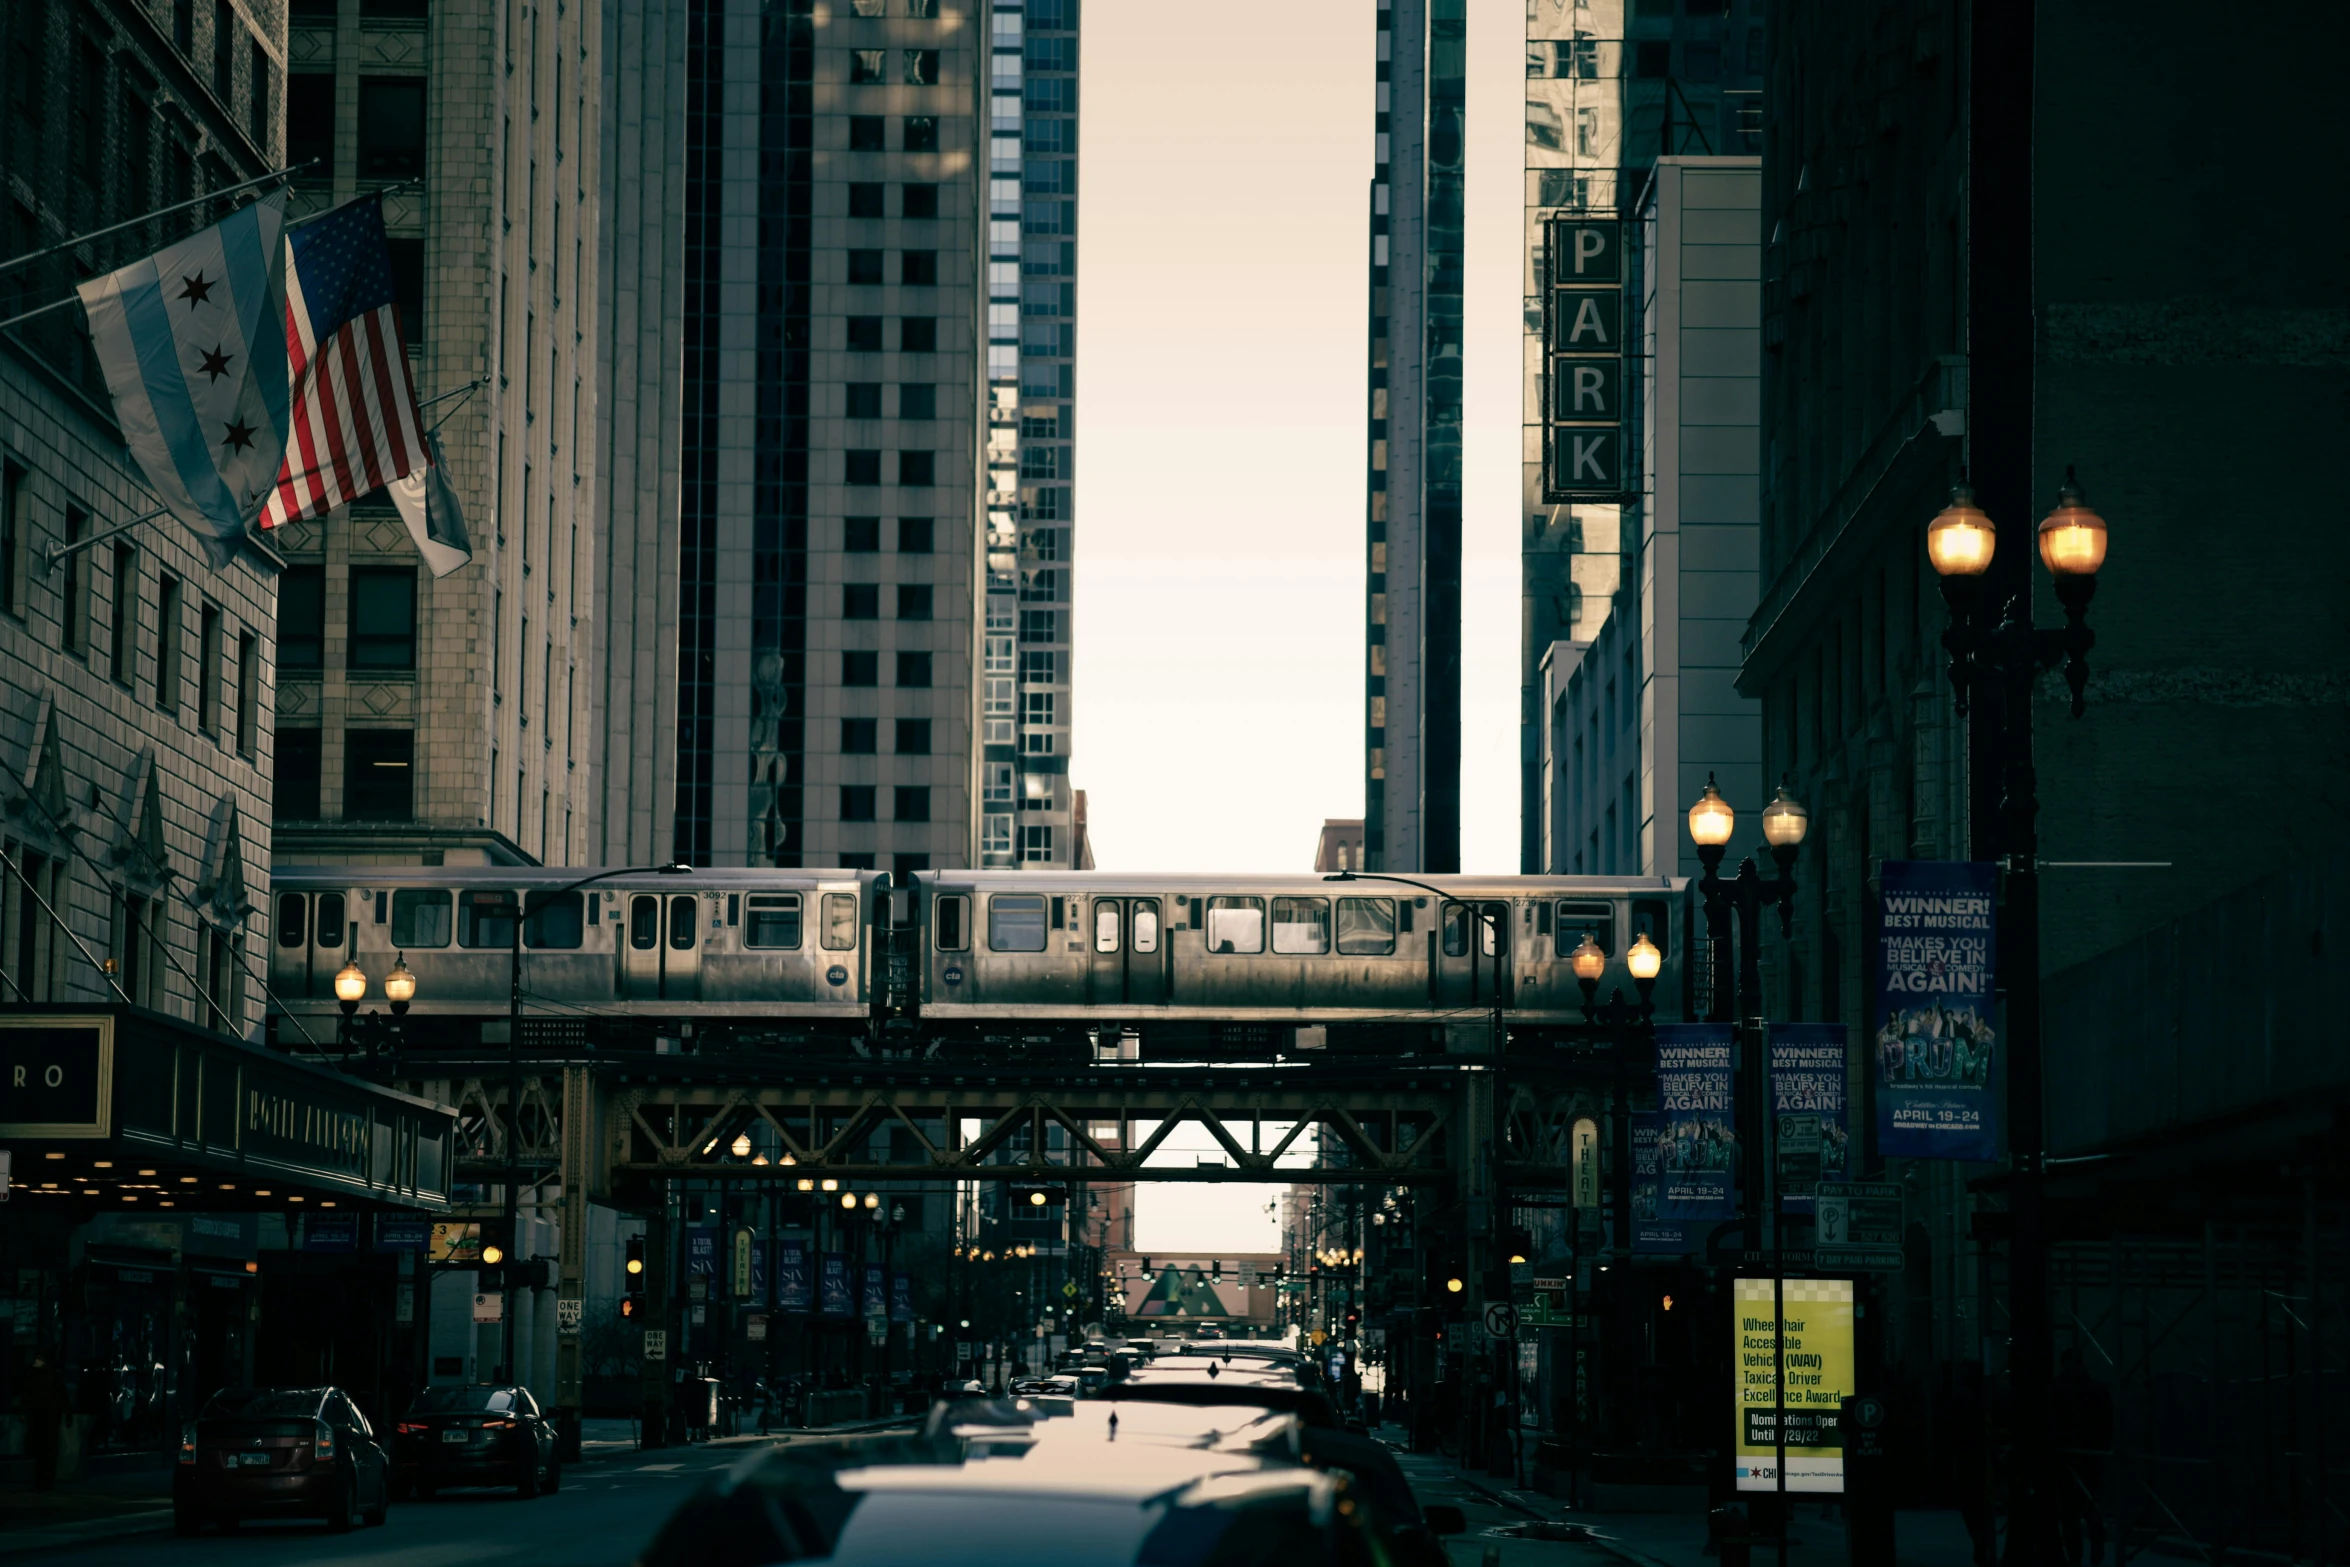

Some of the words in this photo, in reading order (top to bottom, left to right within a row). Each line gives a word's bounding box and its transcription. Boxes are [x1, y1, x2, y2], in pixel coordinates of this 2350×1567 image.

[1569, 229, 1608, 480] PARK
[703, 891, 726, 899] 3092
[1067, 894, 1087, 902] 2739
[1516, 899, 1537, 907] 2739
[1884, 897, 1990, 915] WINNER!
[1884, 914, 1921, 928] BEST
[1923, 915, 1991, 929] MUSICAL
[1949, 937, 1986, 951] YOU
[1887, 949, 1962, 964] BELIEVE
[1966, 950, 1986, 964] IN
[1886, 964, 1928, 972] MUSICAL
[1944, 964, 1986, 972] COMEDY
[1659, 1047, 1730, 1059] WINNER!
[1771, 1047, 1843, 1059] WINNER!
[1660, 1059, 1685, 1068] BEST
[1686, 1059, 1731, 1068] MUSICAL
[1772, 1059, 1797, 1068] BEST
[1799, 1059, 1843, 1068] MUSICAL
[1882, 1036, 1991, 1083] PROM
[1704, 1072, 1728, 1082] YOU
[1816, 1073, 1841, 1082] YOU
[1662, 1081, 1713, 1091] BELIEVE
[1715, 1081, 1728, 1091] IN
[1775, 1081, 1826, 1091] BELIEVE
[1828, 1082, 1841, 1091] IN
[1893, 1109, 1934, 1121] APRIL
[1661, 1138, 1731, 1169] PROM
[1581, 1134, 1589, 1203] THEAT
[1668, 1186, 1694, 1195] APRIL
[1823, 1185, 1844, 1195] PAY
[1847, 1186, 1862, 1196] TO
[1866, 1187, 1896, 1196] PARK
[698, 1238, 712, 1246] TOTAL
[692, 1246, 713, 1255] BLAST!
[1819, 1255, 1824, 1264] 7
[1826, 1255, 1842, 1264] DAY
[1844, 1255, 1863, 1264] PAID
[1865, 1255, 1901, 1265] PARKING
[1534, 1279, 1566, 1287] UNKIN'
[559, 1302, 579, 1310] ONE
[559, 1311, 579, 1320] WAY
[1743, 1317, 1805, 1332] Wheehair
[1743, 1335, 1801, 1350] Accesible
[1743, 1353, 1777, 1366] Vehicl
[1786, 1353, 1822, 1370] (WAV)
[1576, 1351, 1586, 1406] PARK
[1789, 1371, 1822, 1385] Driver
[1743, 1388, 1802, 1403] Excellnce
[1805, 1389, 1841, 1403] Award
[1864, 1403, 1876, 1422] P
[1751, 1413, 1813, 1426] Nomiations
[1751, 1429, 1775, 1441] Until
[1783, 1429, 1819, 1444] /29/22
[1857, 1448, 1883, 1456] PLATE
